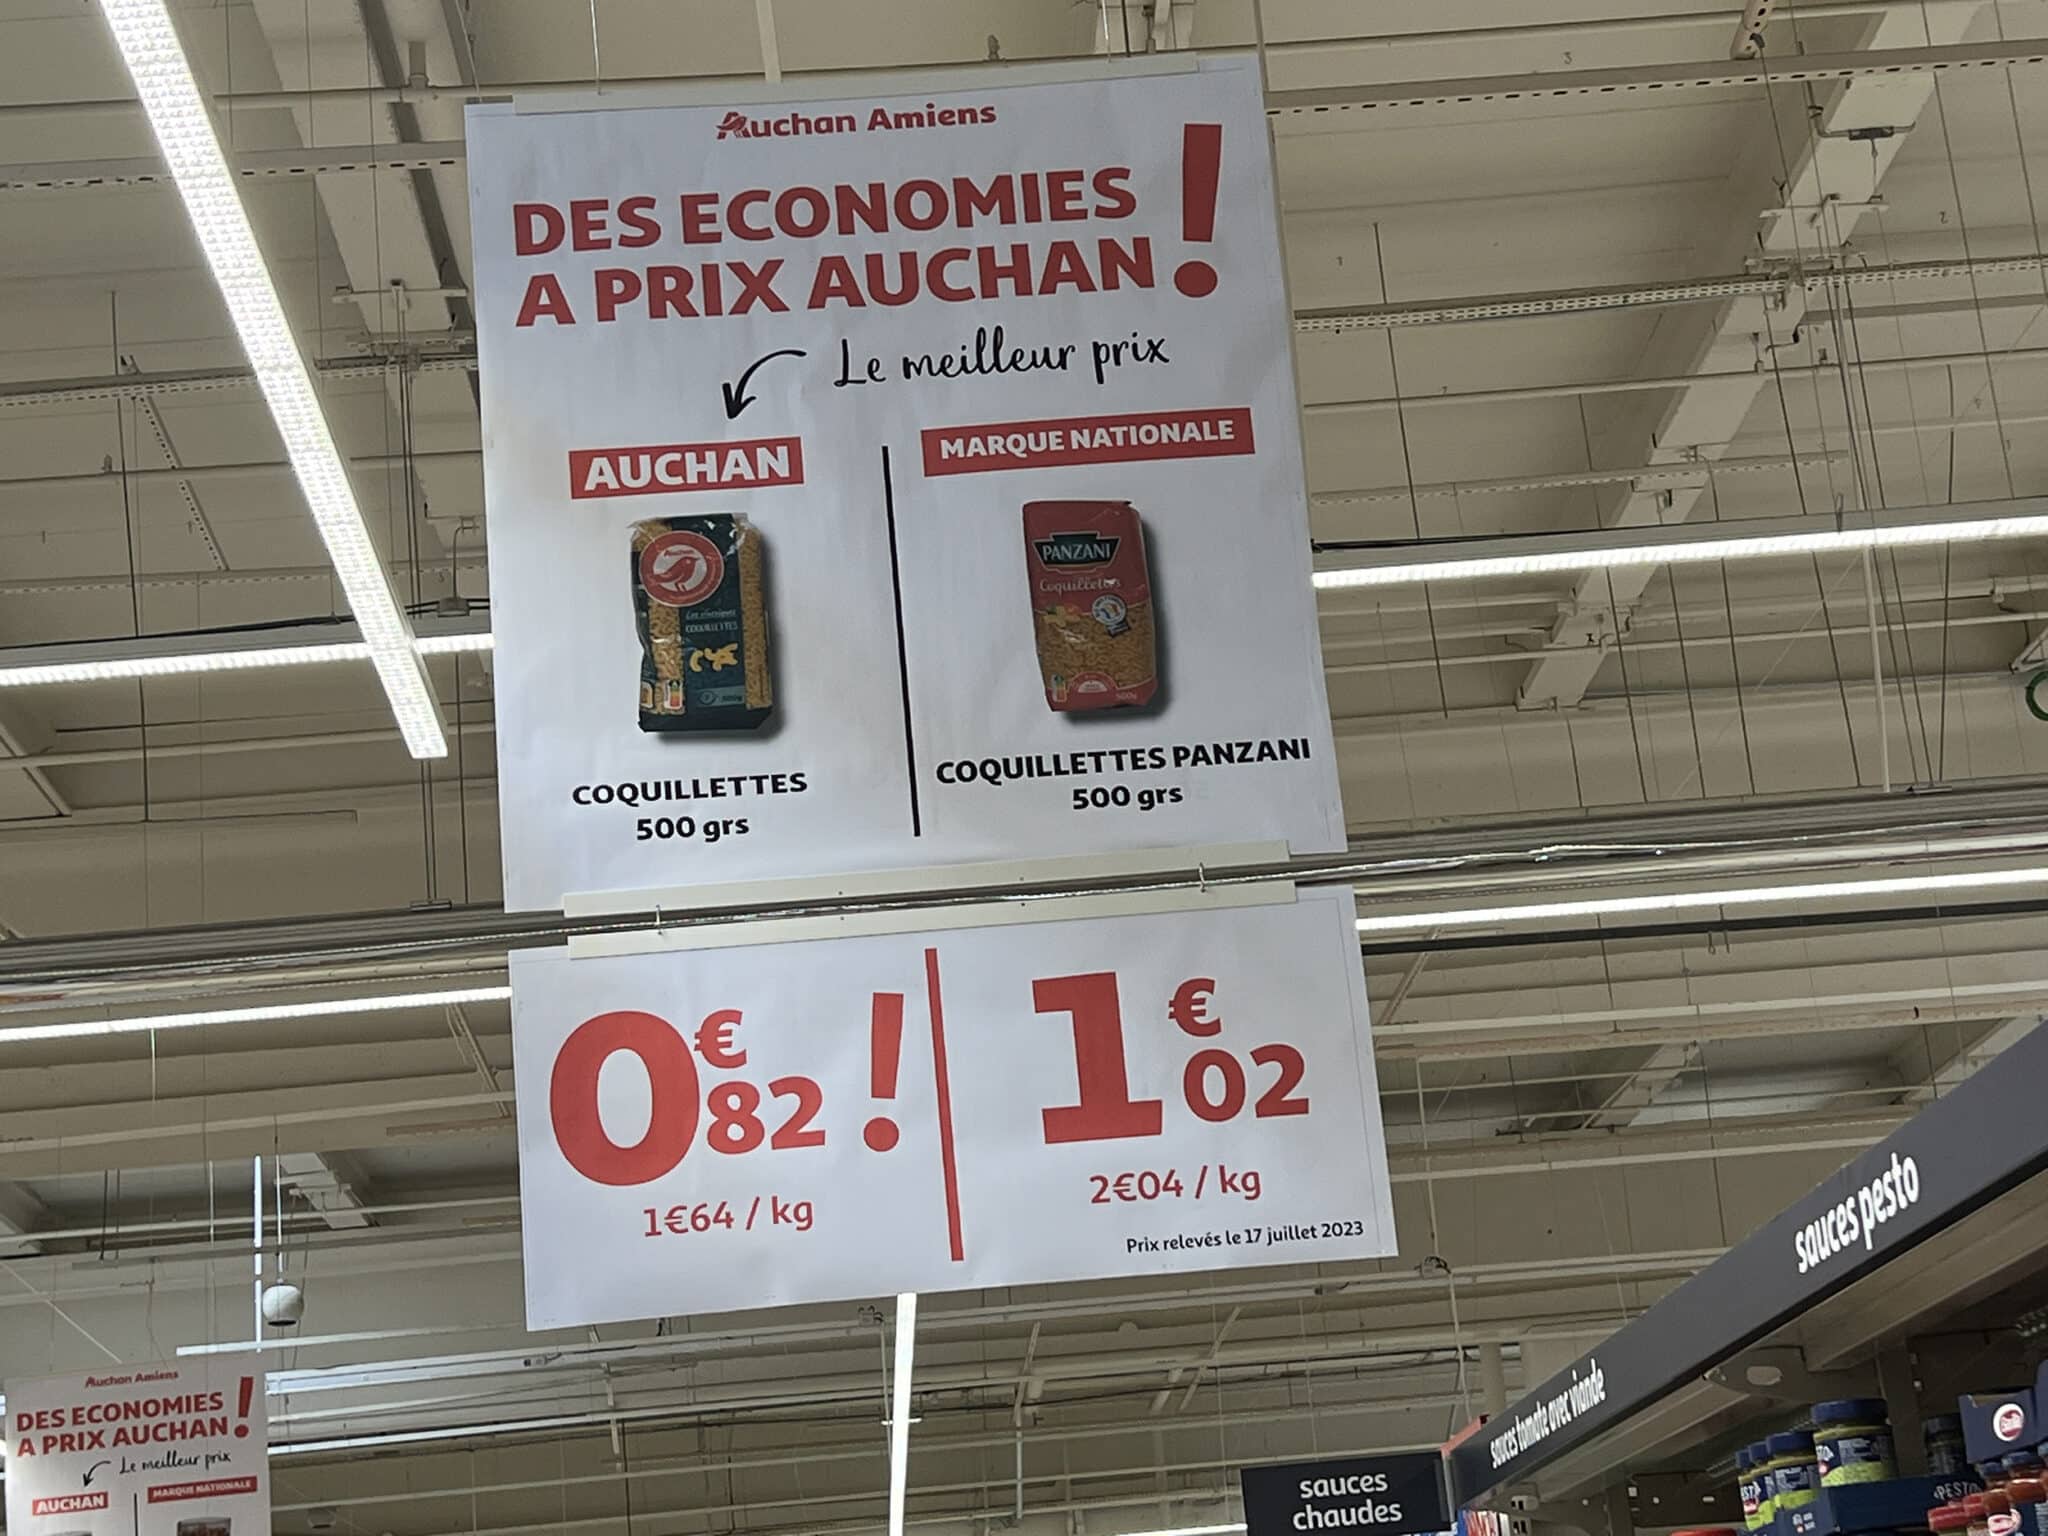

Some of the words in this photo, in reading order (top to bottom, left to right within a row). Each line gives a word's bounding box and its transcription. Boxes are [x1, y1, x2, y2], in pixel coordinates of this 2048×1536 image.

[715, 110, 857, 140] Auchan
[867, 102, 996, 132] Amiens
[513, 197, 661, 256] DES
[681, 166, 1137, 244] ECONOMIES
[515, 273, 576, 327] A
[595, 258, 789, 322] PRIX
[808, 236, 1155, 310] AUCHAN
[833, 337, 887, 388] Le
[901, 325, 1077, 381] meilleur
[1090, 330, 1172, 386] prix
[940, 429, 1065, 460] MARQUE
[1071, 419, 1236, 450] NATIONALE
[583, 445, 791, 492] AUCHAN
[1042, 543, 1112, 561] PANZANI
[935, 747, 1168, 787] COQUILLETTES
[1172, 738, 1312, 769] PANZANI
[572, 772, 809, 808] COQUILLETTES
[1072, 785, 1131, 810] 500
[1137, 786, 1185, 812] grs
[636, 816, 696, 841] 500
[703, 817, 751, 843] grs
[1089, 1170, 1184, 1205] 2€04
[1218, 1164, 1263, 1201] kg
[642, 1201, 735, 1239] 1€64
[770, 1194, 815, 1232] kg
[1795, 1195, 1860, 1274] sauces
[1858, 1151, 1919, 1251] pesto
[1126, 1237, 1160, 1254] Prix
[1163, 1232, 1223, 1251] relevés
[1225, 1230, 1242, 1246] le
[1243, 1228, 1263, 1244] 17
[1265, 1224, 1318, 1247] juillet
[1321, 1220, 1365, 1239] 2023
[84, 1375, 132, 1388] Auchan
[135, 1370, 180, 1386] Amiens
[16, 1409, 66, 1432] DES
[71, 1391, 224, 1426] ECONOMIES
[1490, 1426, 1519, 1470] sauces
[1547, 1390, 1572, 1432] avec
[1568, 1358, 1606, 1418] viande
[17, 1438, 36, 1457] A
[42, 1432, 105, 1454] PRIX
[112, 1416, 229, 1447] AUCHAN
[119, 1456, 137, 1475] Le
[142, 1450, 201, 1471] meilleur
[204, 1451, 232, 1471] prix
[36, 1495, 105, 1514] AUCHAN
[152, 1482, 195, 1499] MARQUE
[195, 1478, 252, 1493] NATIONALE
[1299, 1472, 1388, 1500] sauces
[1292, 1498, 1403, 1531] chaudes
